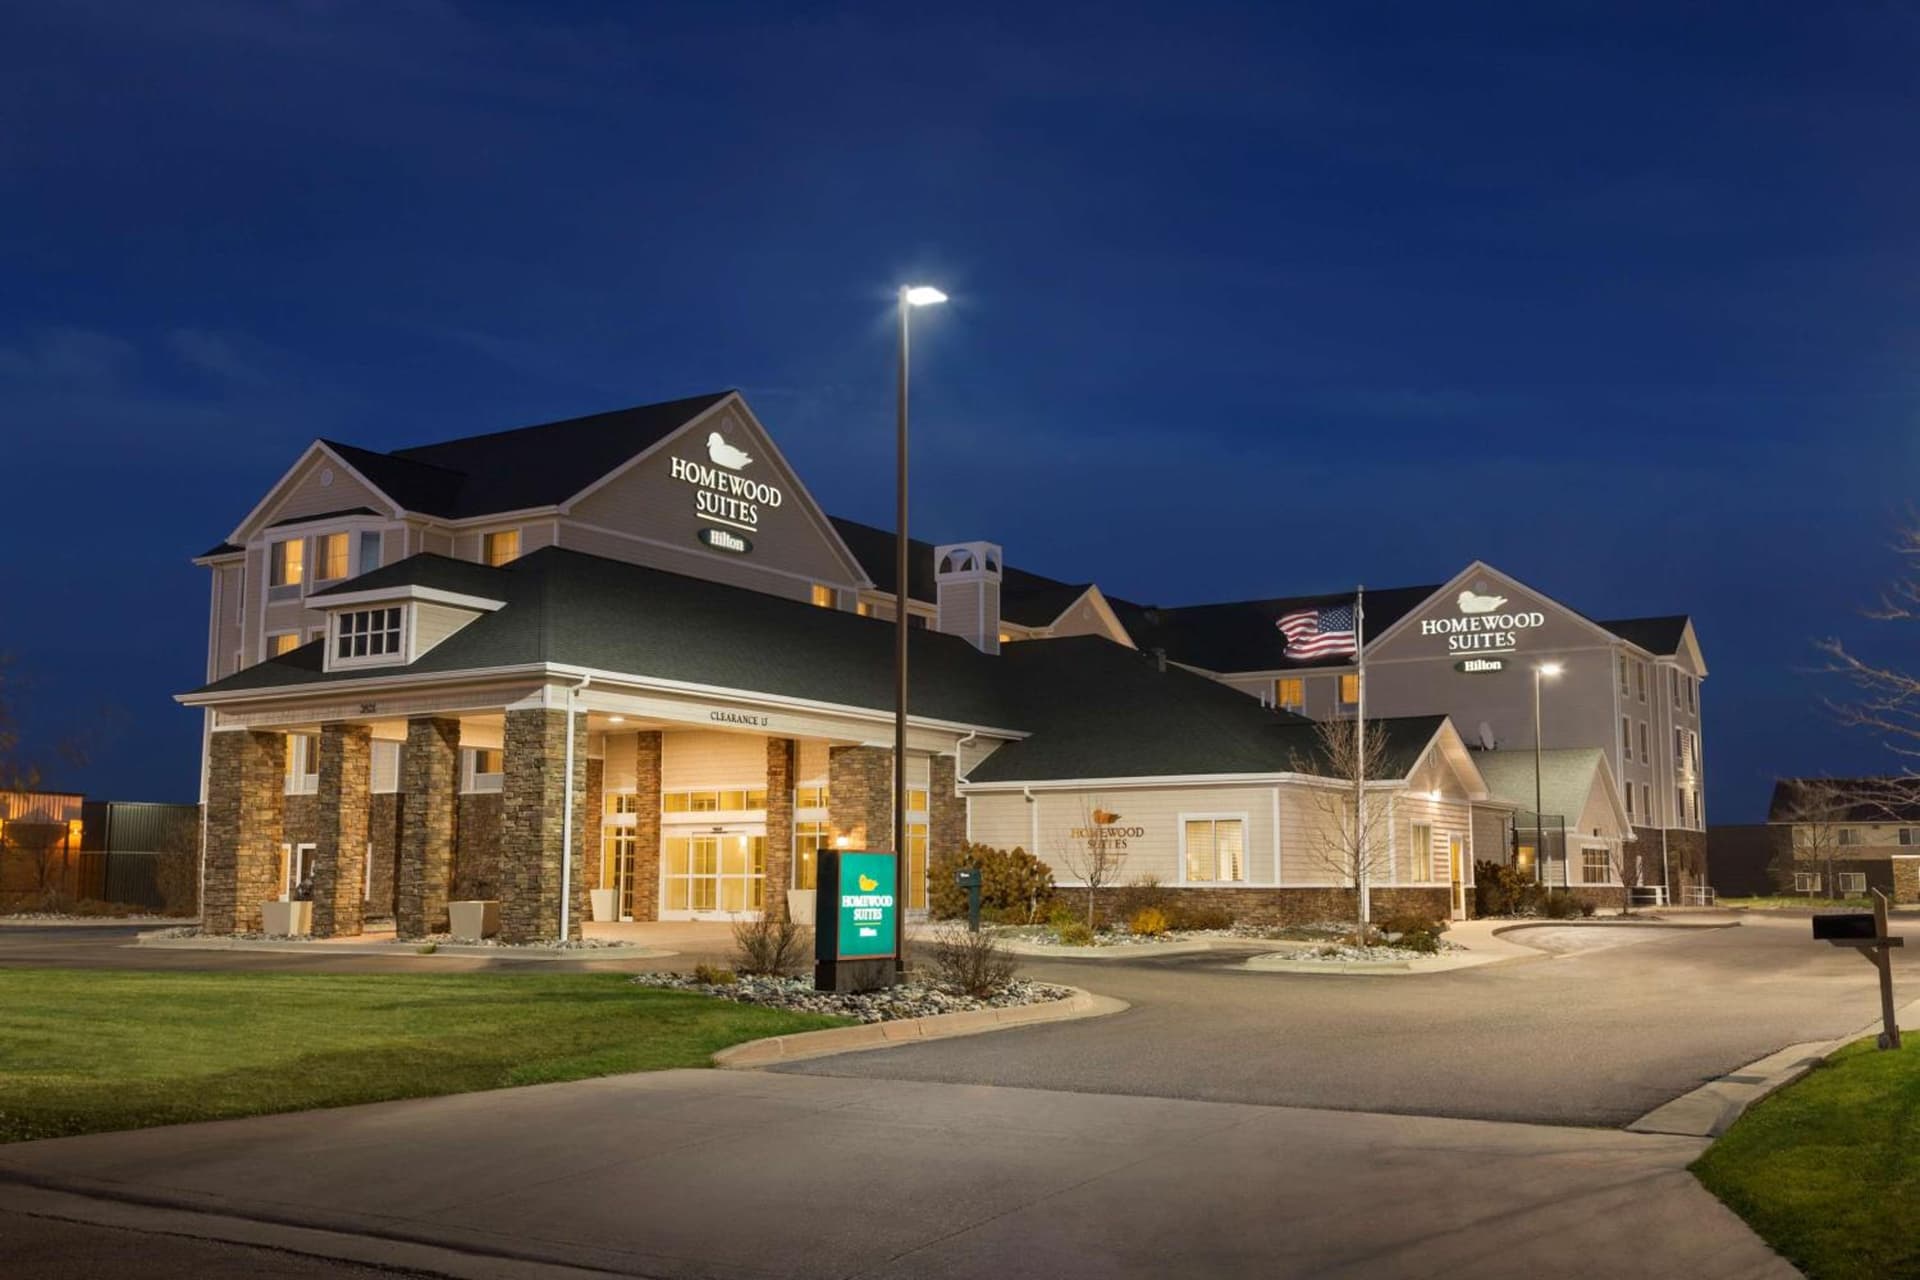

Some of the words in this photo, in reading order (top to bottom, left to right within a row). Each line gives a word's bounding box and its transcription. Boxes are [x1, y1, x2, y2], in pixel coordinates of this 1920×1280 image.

[670, 456, 782, 507] HOMEWOOD
[696, 489, 758, 524] SUITES
[710, 529, 744, 552] Hilton
[1421, 612, 1545, 635] HOMEWOOD
[1449, 631, 1516, 650] SUITES
[1464, 659, 1502, 672] Hilton
[710, 711, 758, 725] CLEARANCE
[841, 895, 893, 907] HOMEWOOD
[854, 908, 883, 920] SUITES
